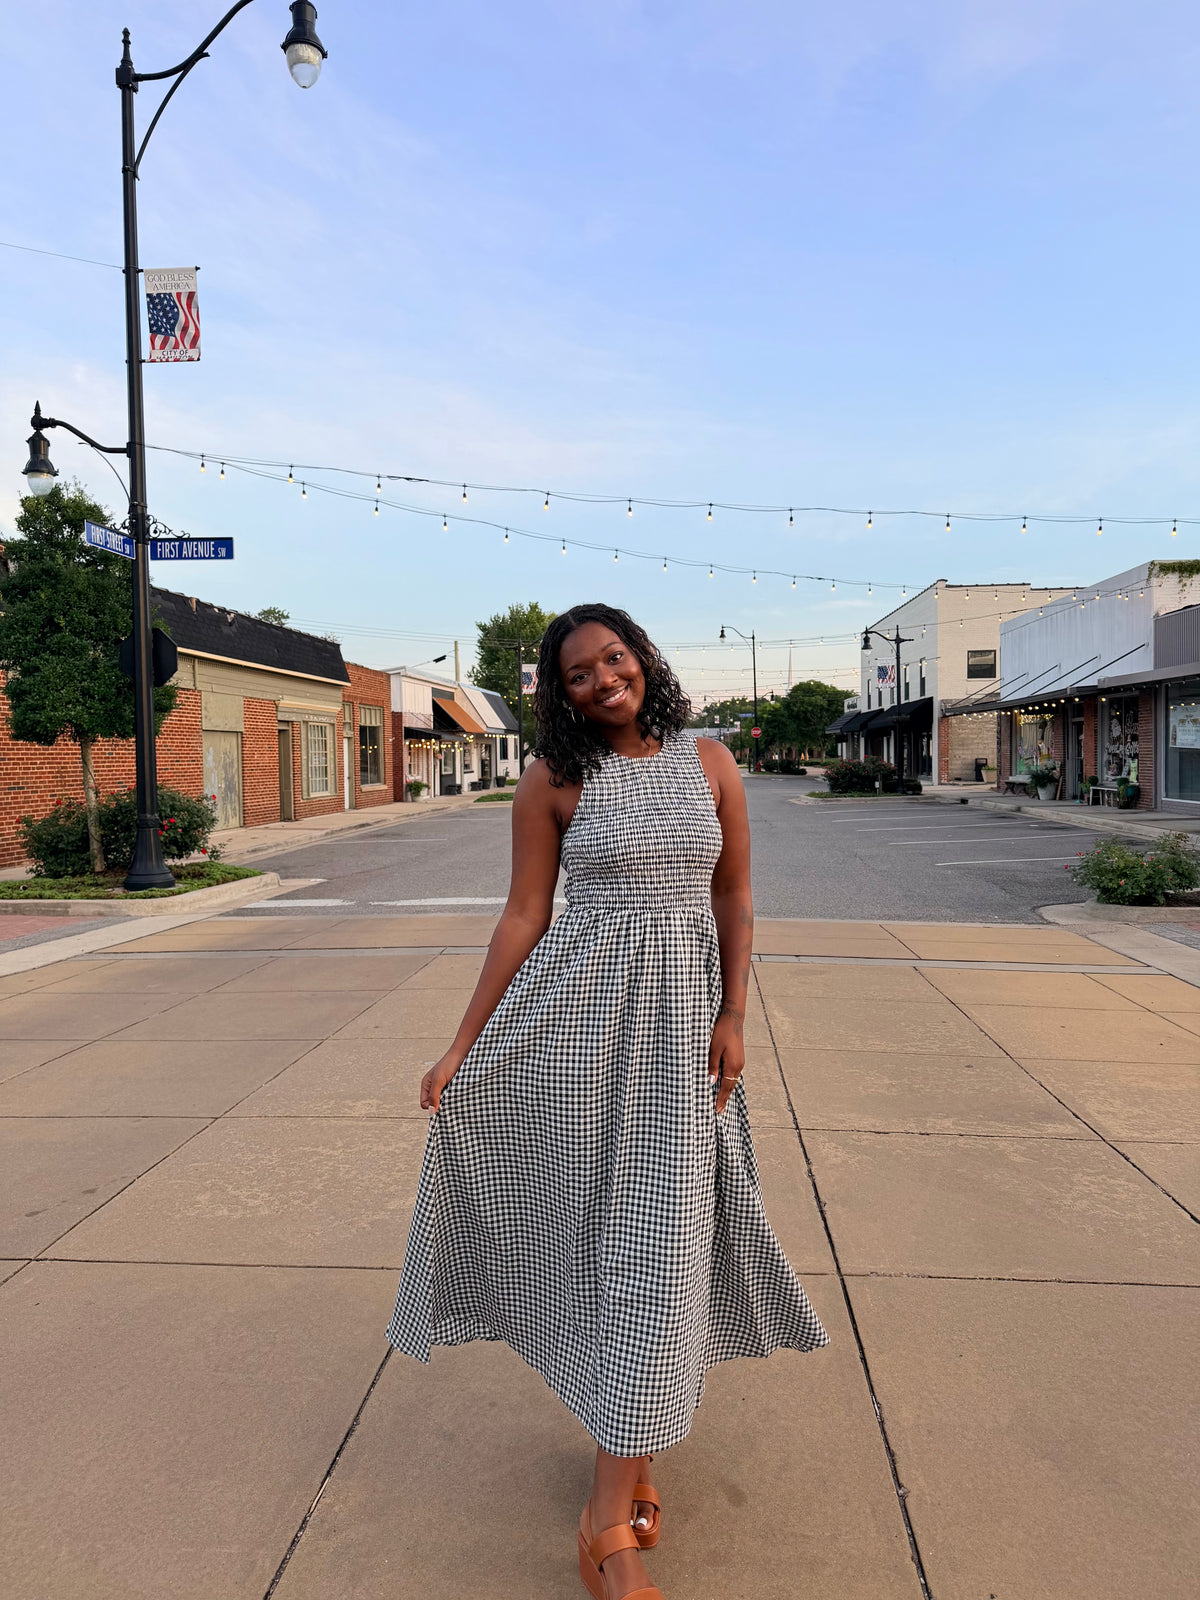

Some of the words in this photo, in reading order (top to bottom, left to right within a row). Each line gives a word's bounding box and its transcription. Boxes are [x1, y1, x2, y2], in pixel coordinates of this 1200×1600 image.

[147, 274, 165, 282] GOD
[167, 273, 193, 281] BLESS
[153, 282, 190, 290] AMERICA
[91, 525, 105, 546] FIRST
[106, 531, 124, 553] STREET
[157, 541, 179, 558] FIRST
[182, 541, 215, 558] AVENUE
[218, 547, 226, 557] SW
